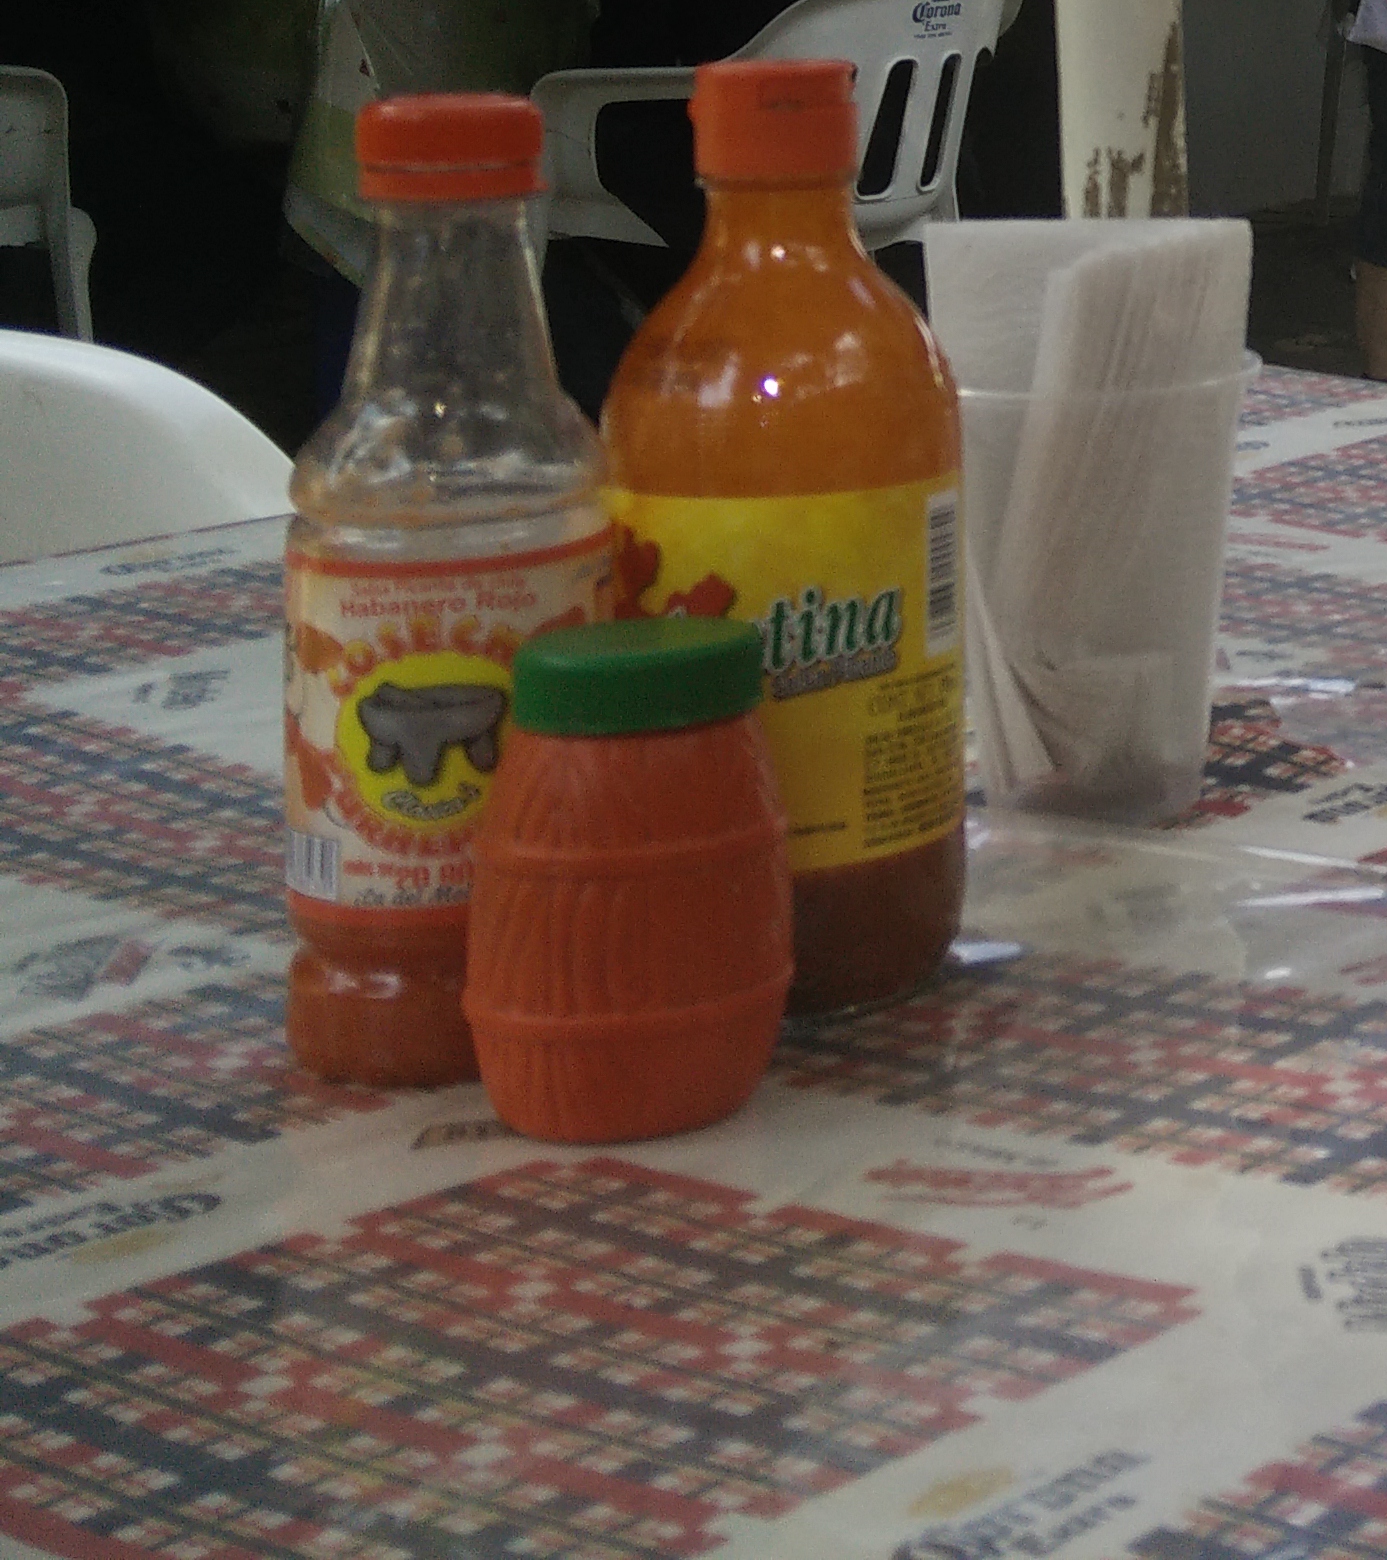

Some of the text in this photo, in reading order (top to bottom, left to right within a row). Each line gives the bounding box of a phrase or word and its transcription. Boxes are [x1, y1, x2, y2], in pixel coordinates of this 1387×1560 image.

[912, 2, 961, 25] Corona
[340, 590, 538, 618] Habanero Rojo
